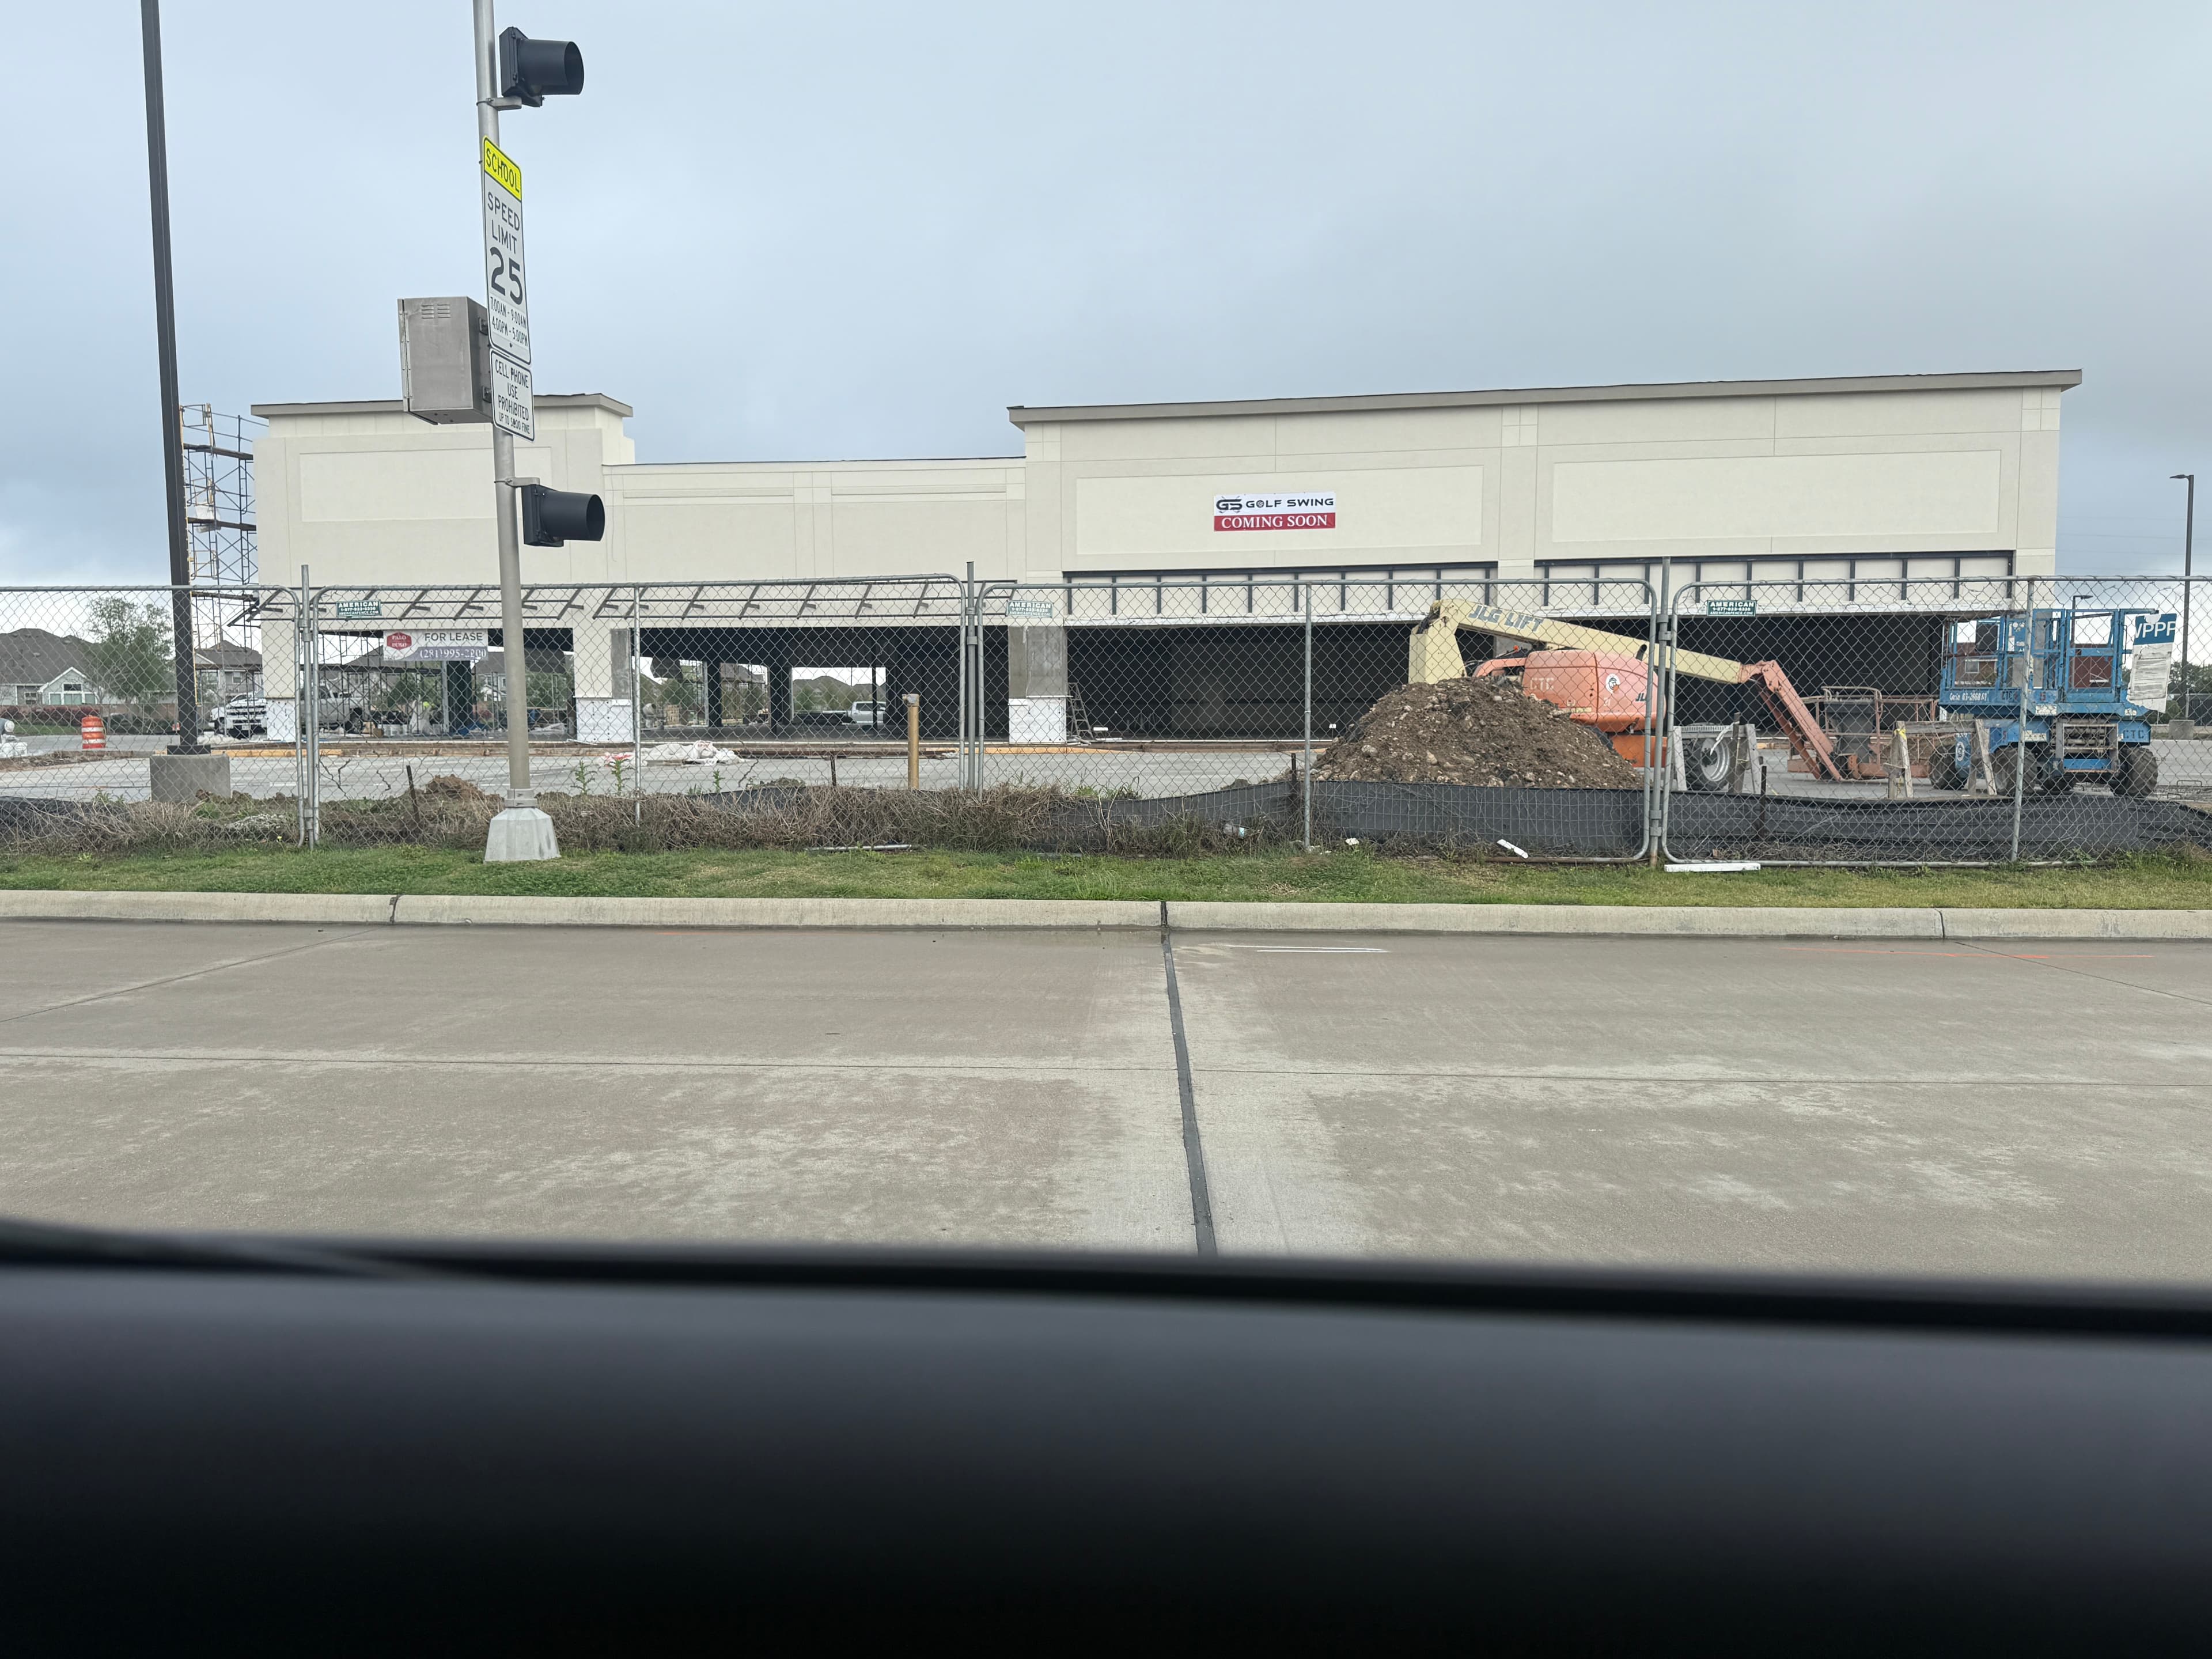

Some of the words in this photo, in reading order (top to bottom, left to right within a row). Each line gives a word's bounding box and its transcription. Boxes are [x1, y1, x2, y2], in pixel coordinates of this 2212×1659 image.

[486, 148, 520, 193] SCHOOL
[487, 191, 520, 231] SPEED
[492, 219, 517, 254] LIMIT
[490, 247, 523, 305] 25
[490, 296, 506, 317] 7:00AM
[511, 309, 527, 329] 9:00AM
[492, 316, 508, 336] 4:00PM
[513, 327, 528, 347] 5:00PM
[495, 359, 509, 379] CELL
[510, 368, 529, 388] PHONE
[507, 382, 518, 400] USE
[498, 395, 529, 421] PROHIBITED
[499, 411, 504, 422] UP
[505, 414, 510, 425] TO
[522, 422, 530, 434] FINE
[1245, 499, 1282, 508] GOLF
[1287, 498, 1334, 507] SWING
[1221, 516, 1283, 529] COMING
[1287, 514, 1327, 527] SOON
[1468, 605, 1503, 623] JLG
[1504, 612, 1544, 632] LIFT
[425, 632, 446, 641] FOR
[449, 632, 483, 641] LEASE
[1635, 692, 1646, 702] JL
